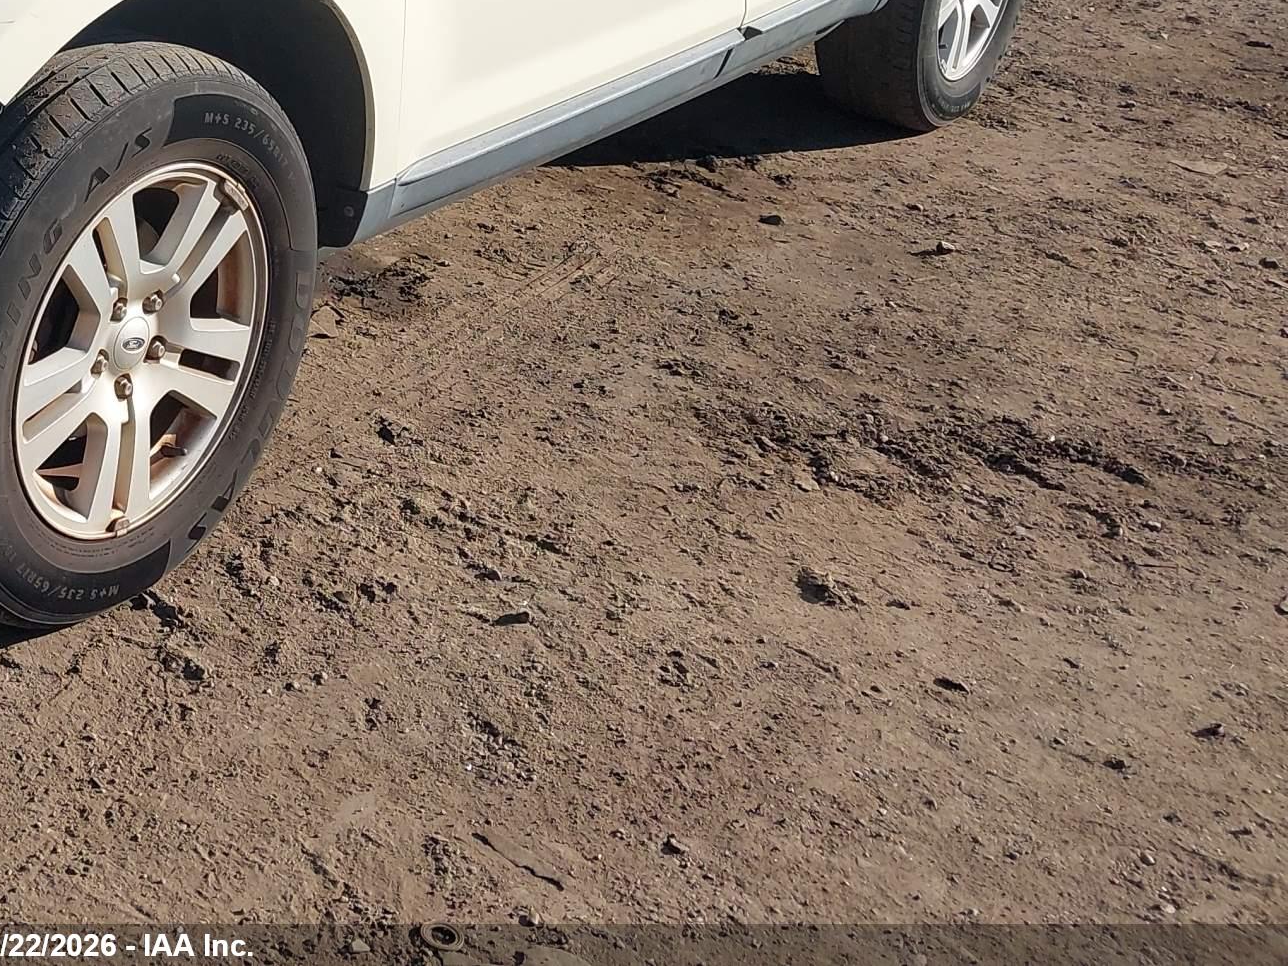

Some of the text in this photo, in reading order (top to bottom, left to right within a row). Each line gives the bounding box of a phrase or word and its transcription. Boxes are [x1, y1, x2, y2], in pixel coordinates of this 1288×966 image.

[84, 126, 153, 203] A/S
[203, 111, 290, 168] M+S 235/65R17
[90, 583, 121, 601] M+S
